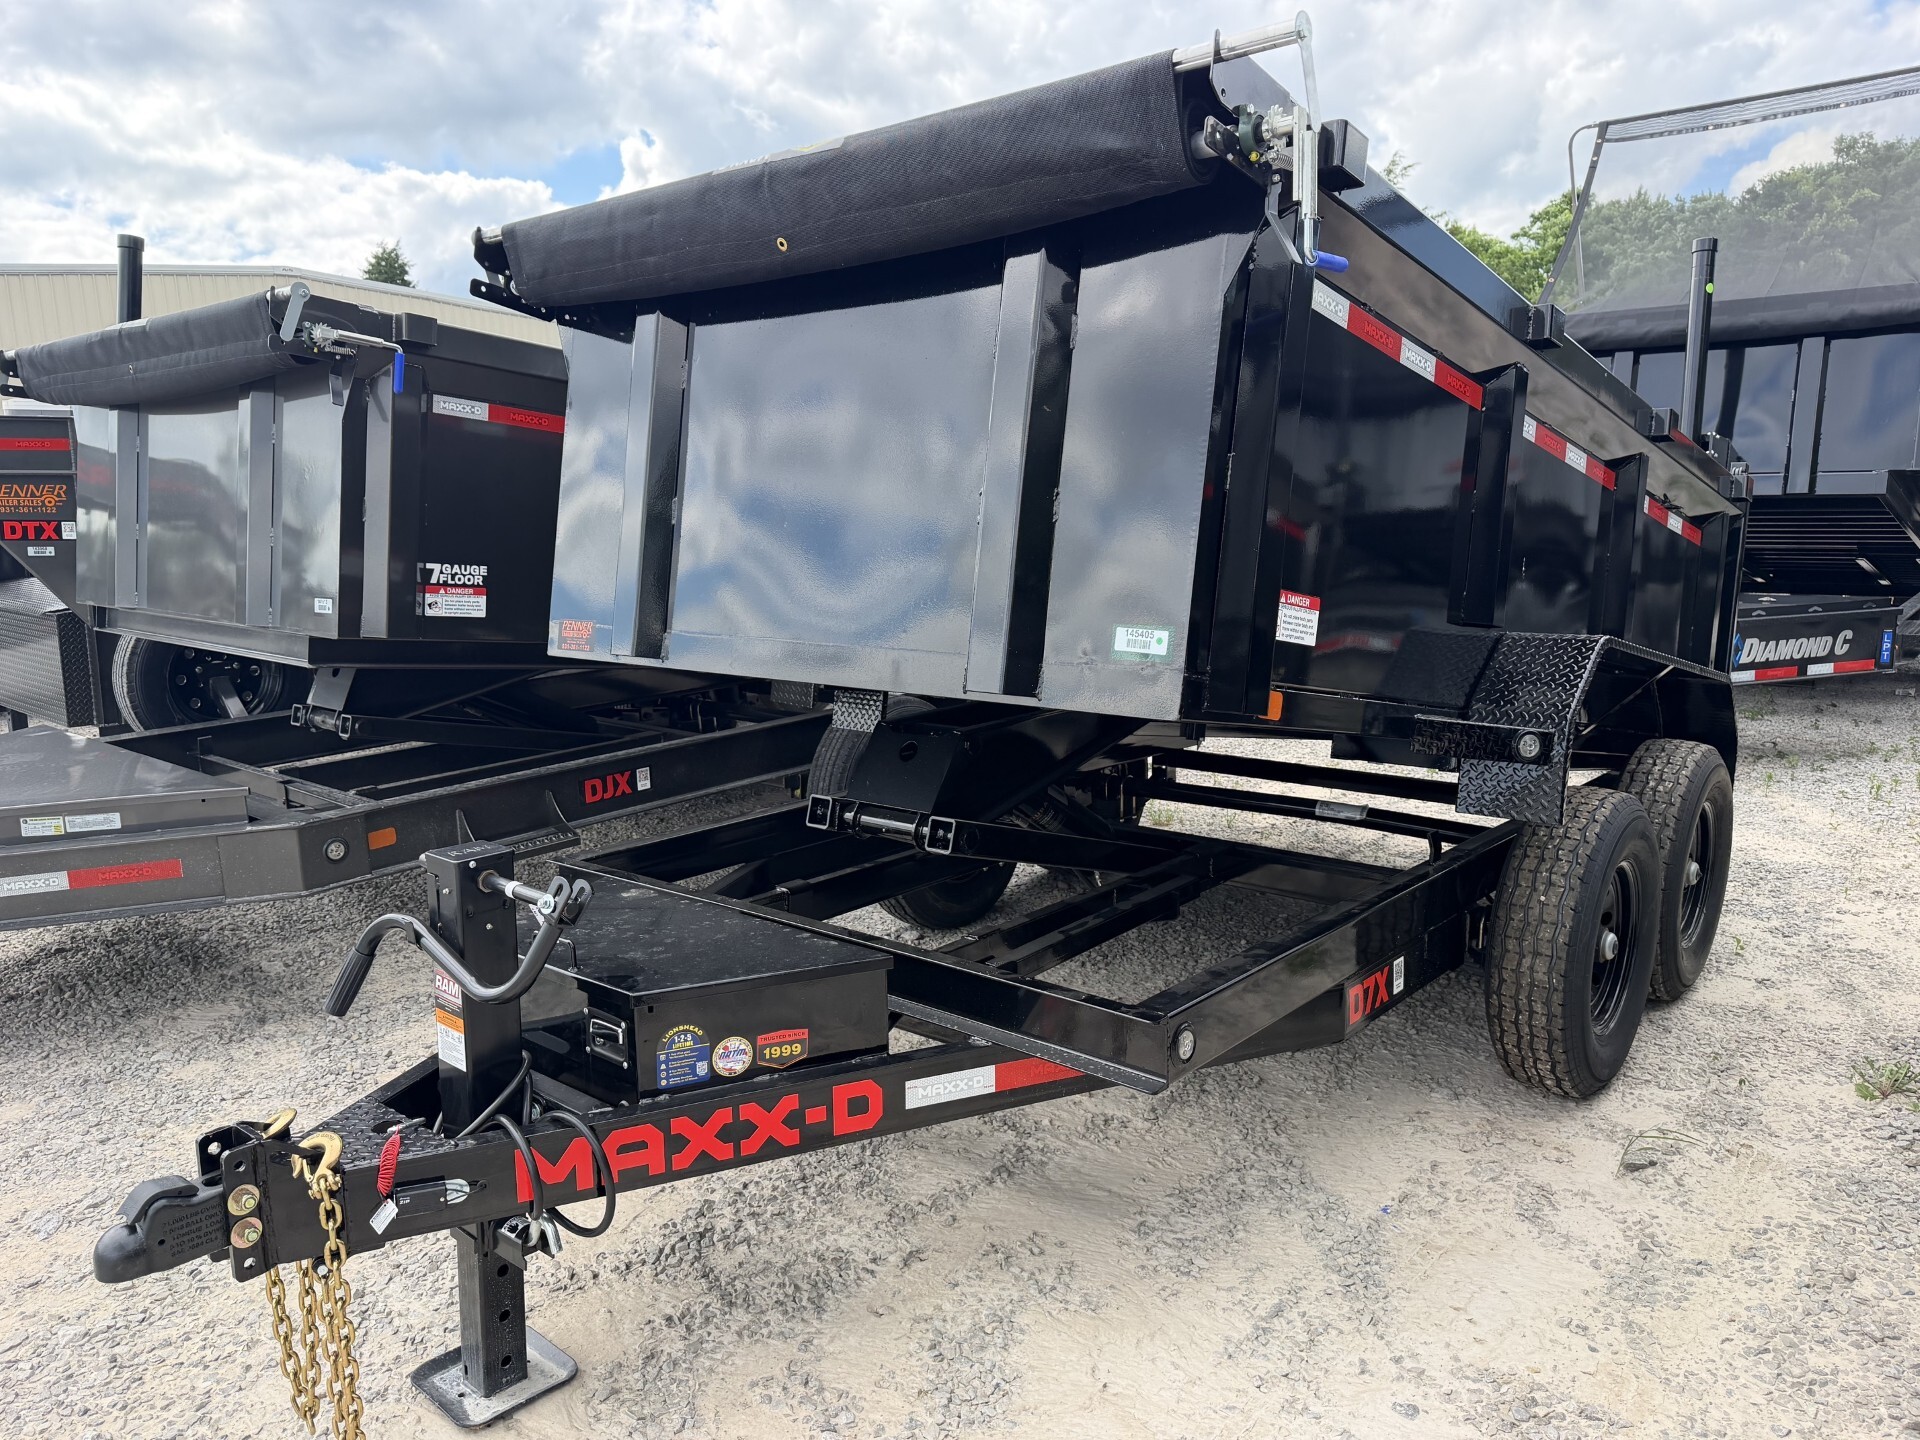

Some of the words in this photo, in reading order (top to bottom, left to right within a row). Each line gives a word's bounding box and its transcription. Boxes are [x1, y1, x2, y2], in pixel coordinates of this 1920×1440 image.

[1405, 349, 1432, 372] MAXX-D
[440, 401, 482, 415] MAXX-D
[510, 412, 549, 426] MAXX-D
[15, 440, 51, 448] MAXX-D
[3, 521, 59, 539] DTX
[425, 562, 442, 584] 7
[442, 563, 488, 576] GAUGE
[439, 574, 483, 586] FLOOR
[1287, 594, 1310, 607] DANGER
[562, 620, 593, 631] PENNER
[1126, 629, 1155, 639] 145405
[1739, 635, 1833, 664] DIAMOND
[1834, 629, 1853, 656] C
[1882, 634, 1892, 660] LPT
[585, 771, 632, 803] DJX
[98, 868, 151, 880] MAXX-D
[3, 878, 59, 891] MAXX-D
[435, 974, 460, 998] RAM
[1349, 965, 1390, 1024] D7X
[662, 1025, 703, 1042] LIONSHEAD
[674, 1034, 692, 1043] 1-2-5
[763, 1043, 802, 1060] 1999
[918, 1075, 984, 1099] MAXX-D
[515, 1079, 883, 1203] MAXX-D
